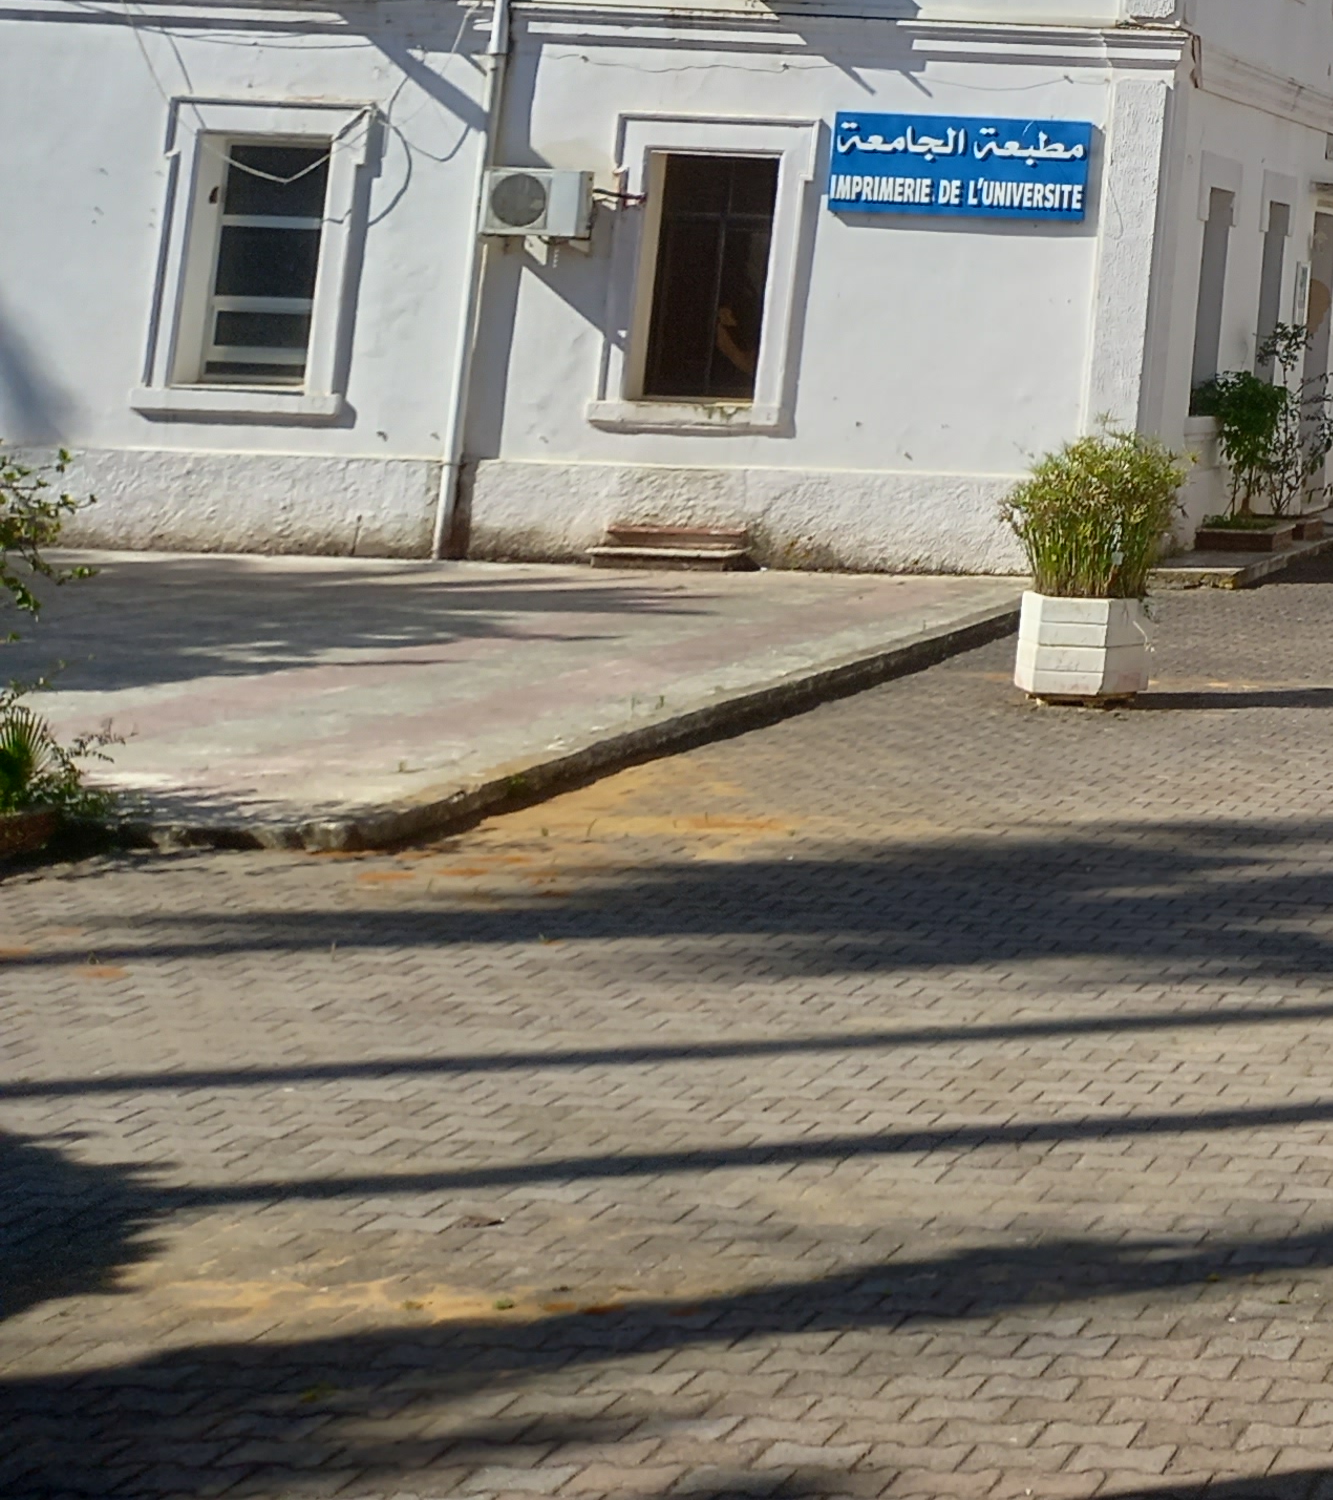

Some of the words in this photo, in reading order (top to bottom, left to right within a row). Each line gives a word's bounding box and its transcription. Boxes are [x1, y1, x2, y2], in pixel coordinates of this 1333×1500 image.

[836, 122, 965, 161] الجامعة
[973, 127, 1084, 165] مطبعة
[830, 174, 932, 203] IMPRIMERIE
[938, 180, 960, 205] DE
[968, 178, 1083, 210] L'UNIVERSITE
